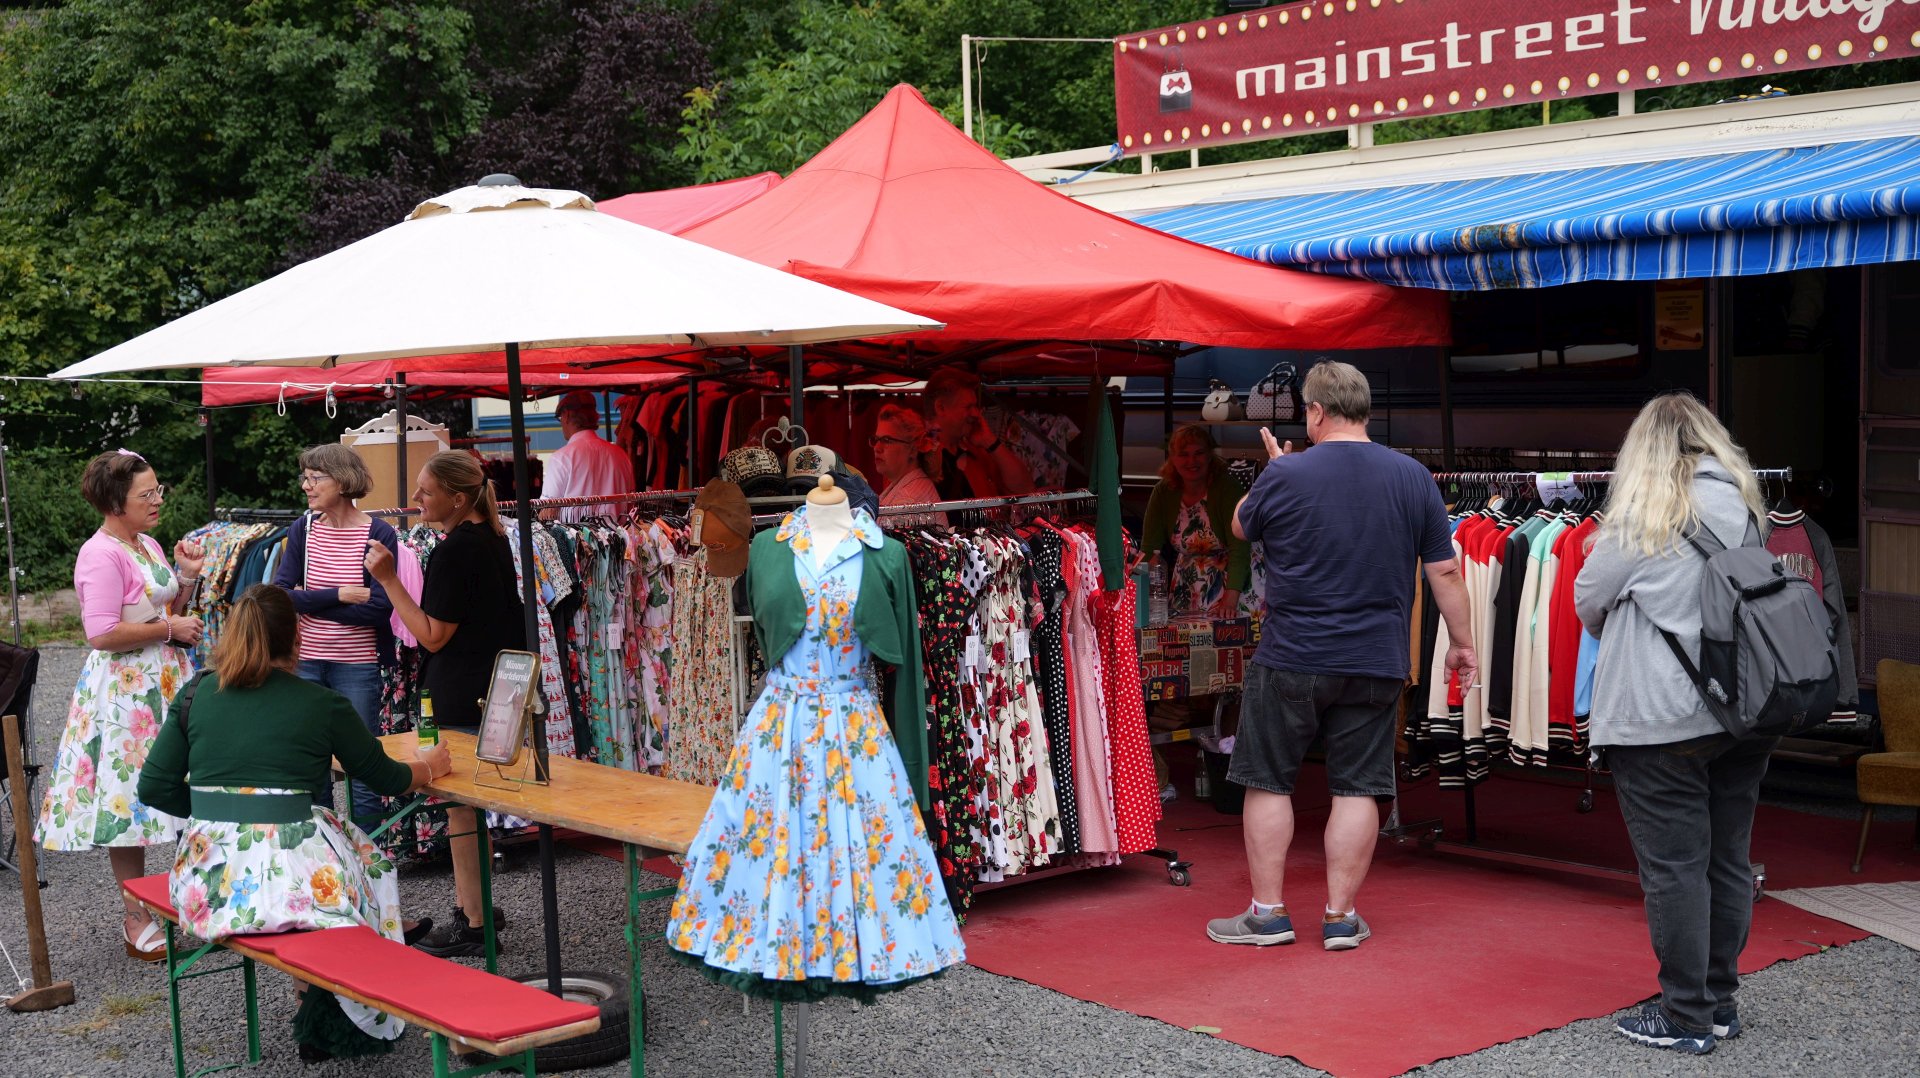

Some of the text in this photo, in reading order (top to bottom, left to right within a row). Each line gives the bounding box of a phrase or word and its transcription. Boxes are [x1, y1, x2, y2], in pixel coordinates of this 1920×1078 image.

[1236, 0, 1648, 99] mainstreet
[1189, 634, 1213, 647] SWEETS
[1227, 649, 1235, 683] OPEN
